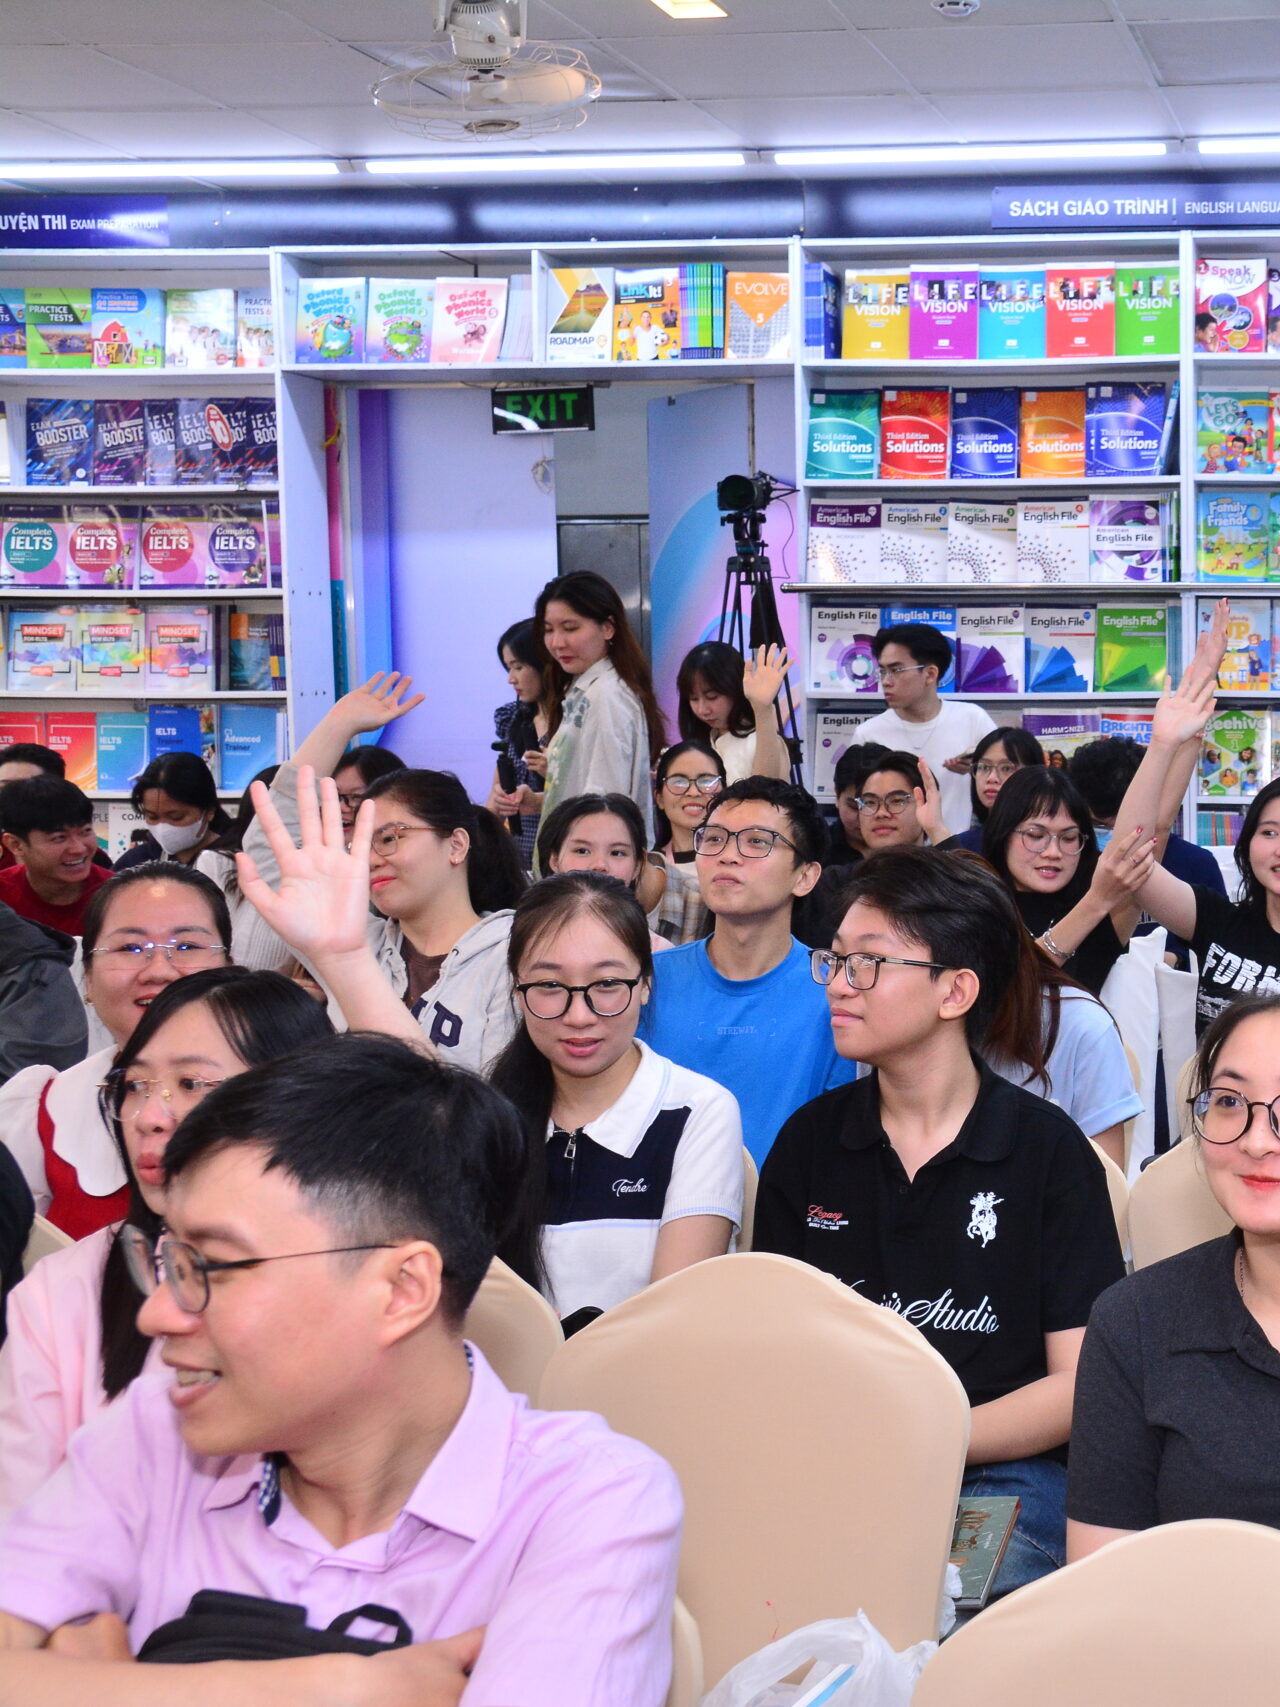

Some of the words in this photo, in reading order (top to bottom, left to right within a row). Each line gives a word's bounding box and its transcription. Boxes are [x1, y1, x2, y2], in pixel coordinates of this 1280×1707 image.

[1009, 200, 1059, 217] SÁCH
[1063, 198, 1109, 216] GIÁO
[1114, 197, 1168, 215] TRÌNH
[1184, 201, 1234, 214] ENGLISH
[0, 212, 39, 232] UYỆN
[42, 215, 66, 230] THI
[71, 219, 95, 229] EXAM
[1211, 265, 1252, 278] Speak
[306, 288, 344, 301] Oxford
[734, 282, 789, 296] EVOLVE
[29, 305, 68, 314] PRACTICE
[303, 296, 350, 314] Phonics
[445, 298, 493, 314] Phonics
[920, 302, 968, 313] VISION
[988, 301, 1036, 313] VISION
[1056, 300, 1105, 311] VISION
[1125, 298, 1173, 310] VISION
[312, 306, 344, 317] World
[454, 307, 487, 319] World
[855, 305, 901, 316] VISION
[49, 313, 74, 322] TESTS
[550, 336, 595, 345] ROADMAP
[506, 393, 578, 422] EXIT
[1213, 413, 1236, 427] GO
[36, 424, 88, 446] BOOSTER
[812, 440, 873, 454] Solutions
[886, 439, 945, 453] Solutions
[955, 440, 1013, 454] Solutions
[1026, 439, 1084, 453] Solutions
[1100, 436, 1158, 451] Solutions
[817, 506, 849, 514] American
[887, 506, 920, 514] American
[954, 505, 986, 514] American
[1024, 504, 1056, 512] American
[1207, 499, 1247, 517] Family
[816, 512, 853, 525] English
[854, 512, 871, 523] File
[887, 512, 923, 524] English
[925, 512, 942, 523] File
[954, 512, 990, 524] English
[991, 514, 1010, 524] File
[1023, 511, 1060, 523] English
[1061, 510, 1078, 521] File
[1207, 513, 1249, 528] Friends
[11, 527, 52, 537] Complete
[77, 528, 117, 537] Complete
[150, 527, 189, 537] Complete
[216, 528, 255, 536] Complete
[10, 537, 52, 550] IELTS
[76, 537, 117, 550] IELTS
[149, 536, 190, 550] IELTS
[215, 536, 255, 550] IELTS
[1096, 534, 1133, 544] English
[1135, 533, 1153, 542] File
[817, 610, 857, 622] English
[859, 610, 878, 620] File
[891, 611, 930, 622] English
[932, 611, 952, 621] File
[960, 616, 996, 628] English
[997, 616, 1015, 625] File
[1031, 616, 1066, 628] English
[1068, 617, 1086, 626] File
[1102, 615, 1139, 628] English
[1140, 616, 1158, 627] File
[22, 626, 64, 635] MINDSET
[90, 626, 131, 635] MINDSET
[158, 626, 199, 635] MINDSET
[823, 716, 862, 727] English
[1101, 720, 1153, 734] BRIGHTE
[1205, 716, 1268, 732] Beehive
[155, 727, 176, 736] IELTS
[1042, 725, 1084, 735] HARMONIZE
[49, 736, 71, 744] IELTS
[100, 736, 122, 744] IELTS
[224, 735, 261, 743] Advanced
[225, 743, 251, 751] Trainer
[612, 1177, 650, 1198] Tendre
[807, 1205, 844, 1221] Legacy
[903, 1288, 999, 1334] Studio
